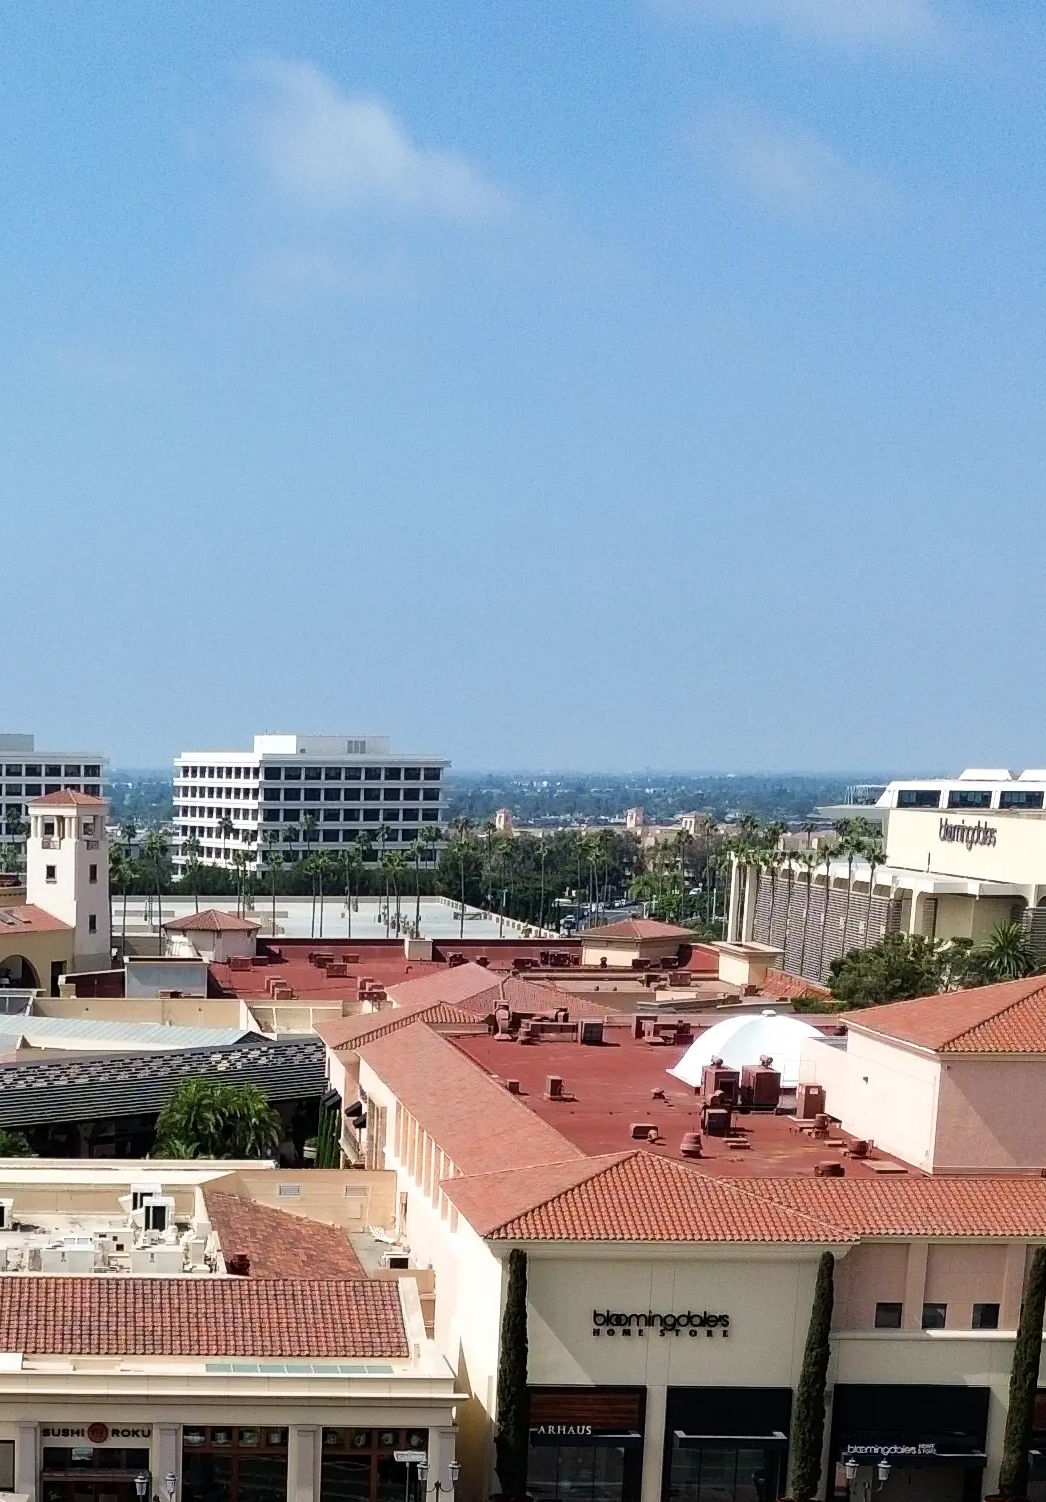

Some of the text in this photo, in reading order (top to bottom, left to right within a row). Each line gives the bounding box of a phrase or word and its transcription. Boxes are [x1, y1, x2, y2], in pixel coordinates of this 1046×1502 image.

[593, 1328, 729, 1338] HOME STORE
[42, 1428, 85, 1438] SUSHI
[111, 1428, 151, 1438] ROKU
[537, 1425, 593, 1435] ARHAUS
